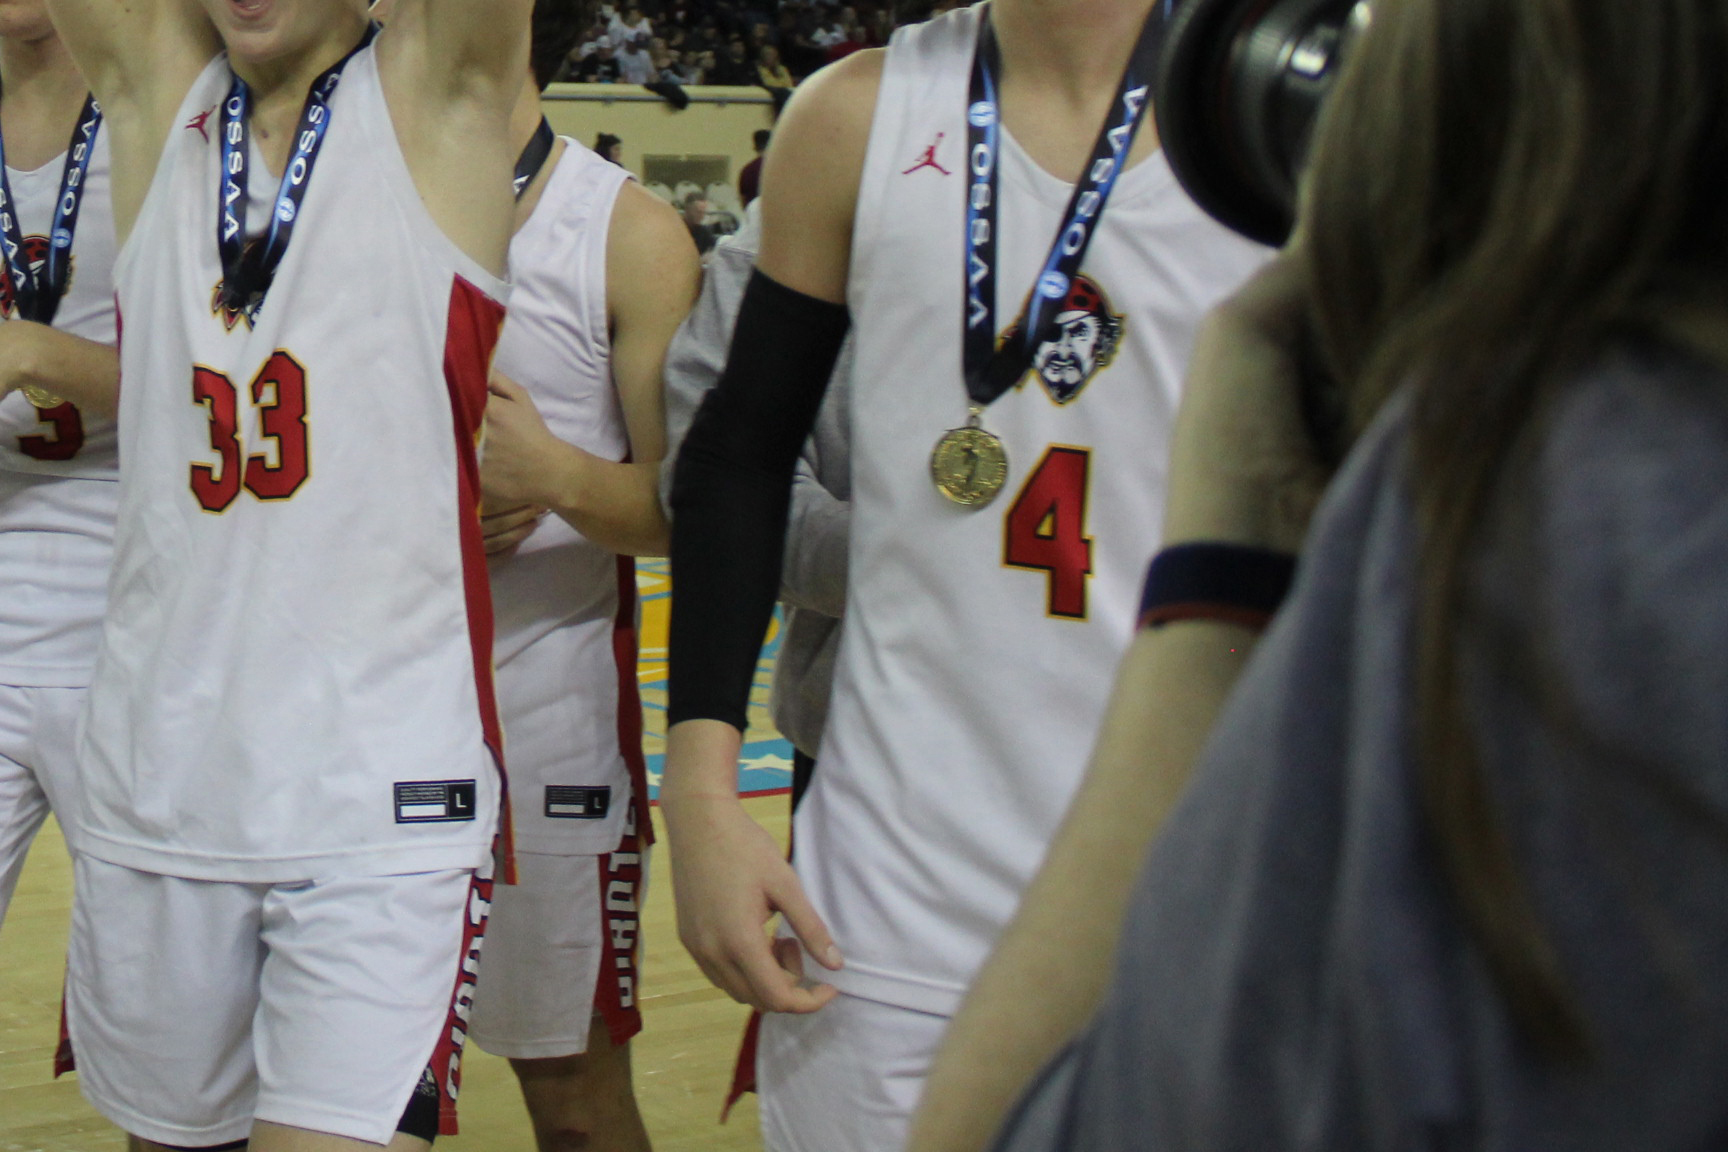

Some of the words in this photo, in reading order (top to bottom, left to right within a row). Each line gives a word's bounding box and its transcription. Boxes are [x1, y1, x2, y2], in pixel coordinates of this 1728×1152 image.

[223, 96, 244, 243] OSSAA
[968, 143, 992, 328] OSSAA
[1063, 85, 1149, 256] OSSAA
[190, 348, 311, 516] 33
[1000, 442, 1096, 623] 4
[455, 792, 468, 809] L
